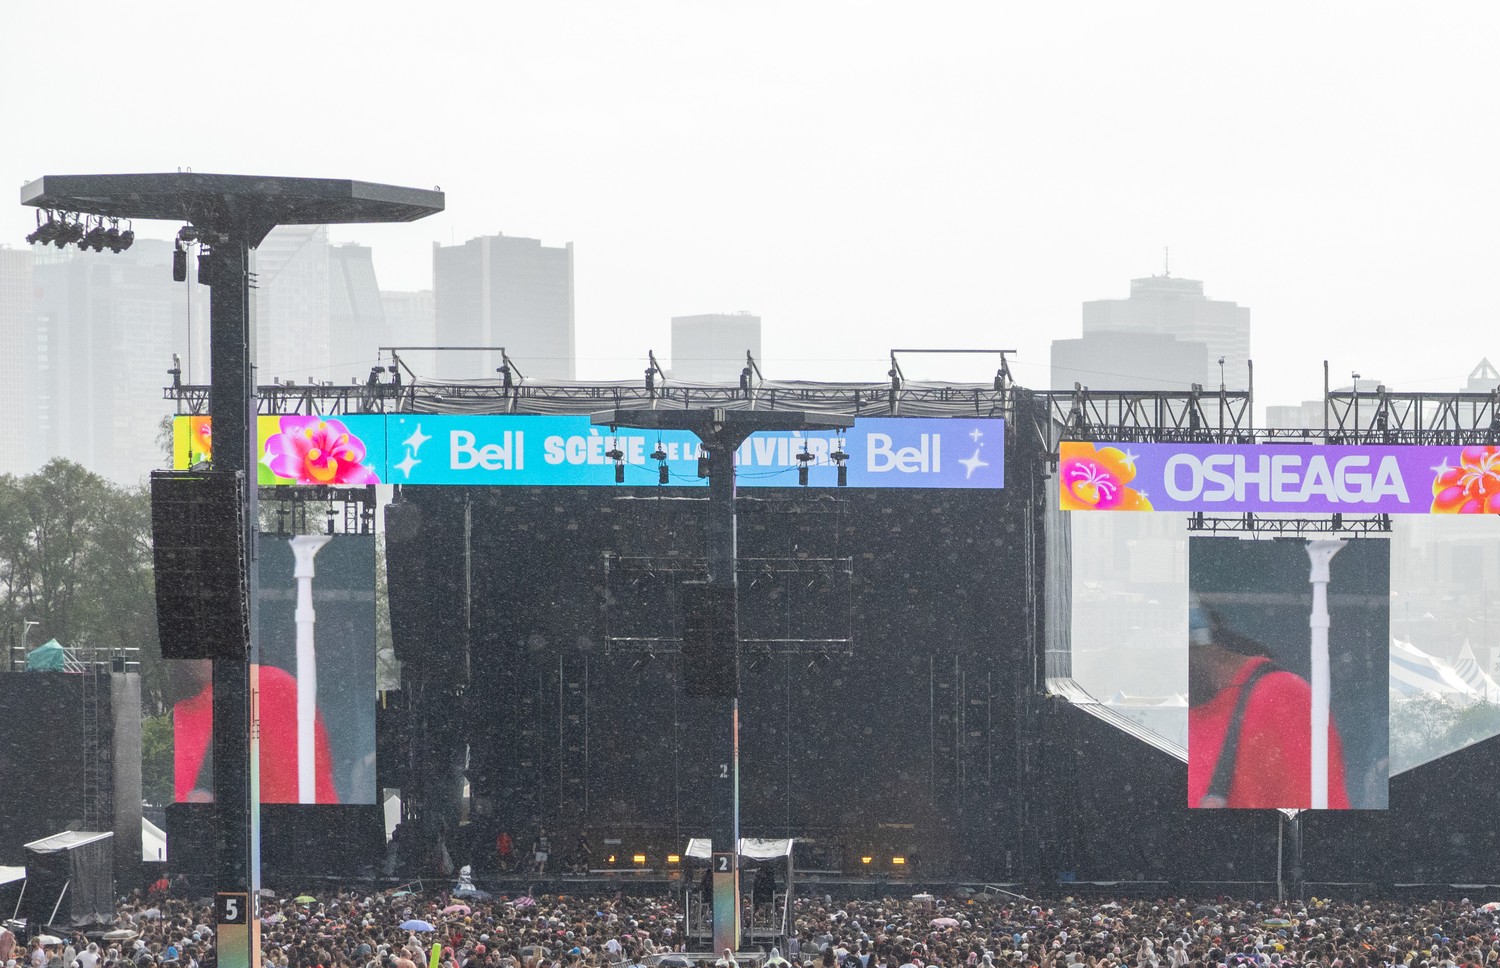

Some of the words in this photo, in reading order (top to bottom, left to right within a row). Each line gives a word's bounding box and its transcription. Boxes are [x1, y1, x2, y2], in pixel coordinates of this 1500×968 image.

[450, 430, 524, 471] Bell
[543, 428, 645, 465] SCÈNE
[735, 431, 846, 466] IVIÈRE
[867, 432, 941, 473] Bell
[1163, 453, 1410, 504] OSHEAGA
[719, 856, 728, 871] 2
[226, 898, 238, 920] 5
